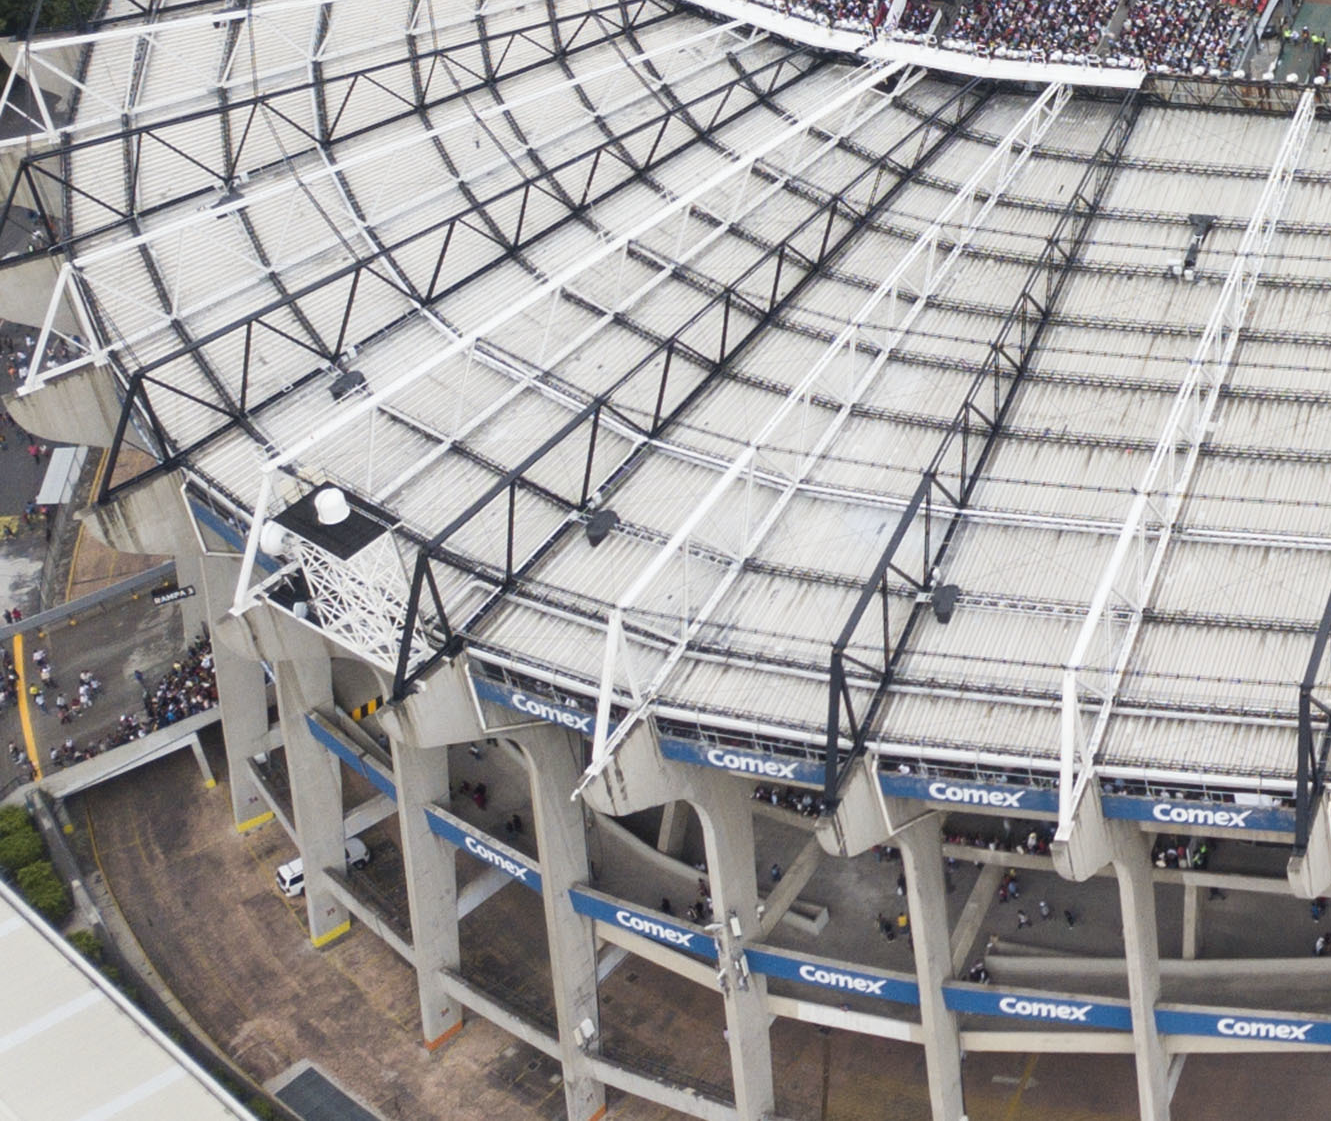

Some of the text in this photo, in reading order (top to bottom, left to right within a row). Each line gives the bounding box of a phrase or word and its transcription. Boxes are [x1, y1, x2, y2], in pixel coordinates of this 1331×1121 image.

[154, 590, 187, 604] RAMPA
[511, 693, 591, 733] Comex
[706, 749, 798, 779] Comex
[929, 782, 1026, 808] Comex
[1153, 803, 1252, 828] Comex
[464, 835, 529, 881] Comex
[616, 909, 695, 946] Comex
[799, 964, 887, 994] Comex
[999, 996, 1092, 1021] Comex
[1216, 1016, 1314, 1041] Comex
